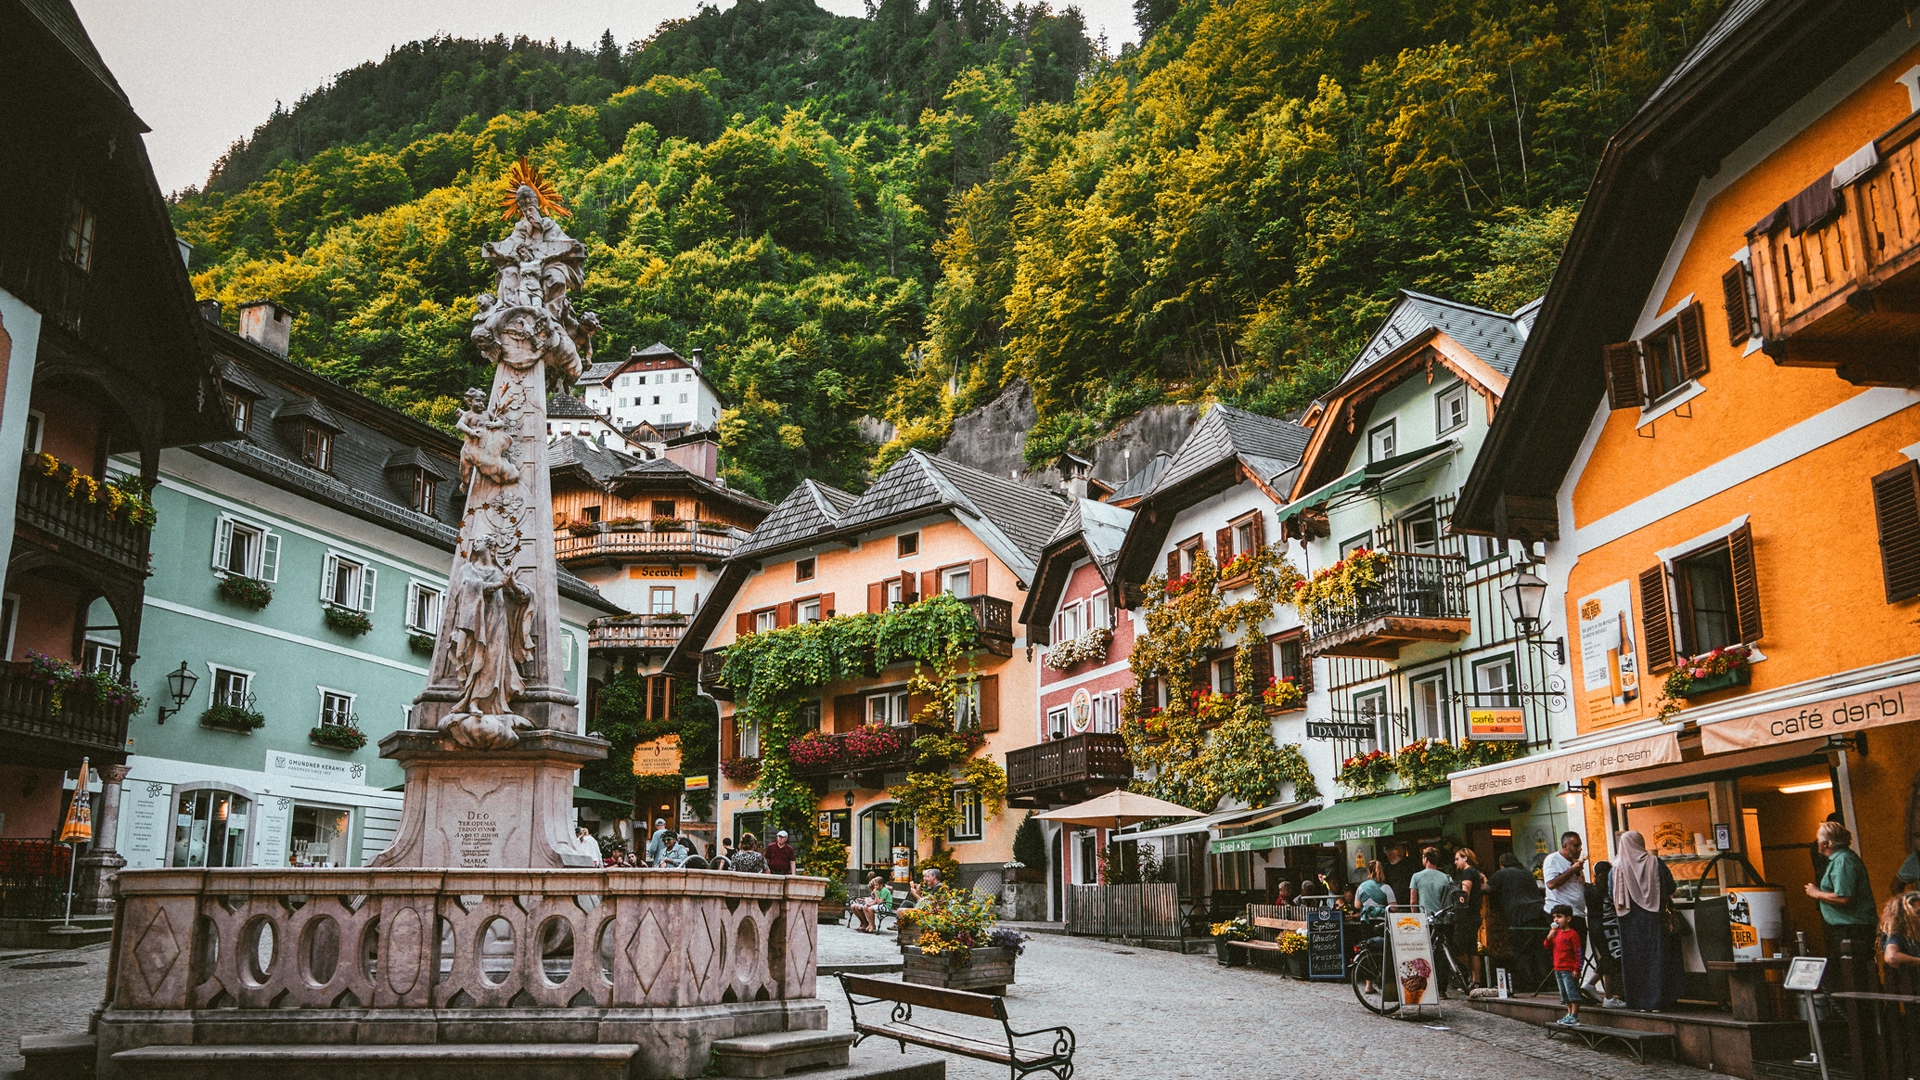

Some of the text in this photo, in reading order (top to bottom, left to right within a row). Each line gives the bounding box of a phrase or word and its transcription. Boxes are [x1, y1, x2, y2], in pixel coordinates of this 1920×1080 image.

[642, 566, 683, 577] Seewirt
[1770, 708, 1824, 736] café
[288, 759, 345, 772] GMUNDNER KERAMIK
[1467, 749, 1651, 793] italienisches eis italian ice-cream
[1220, 842, 1235, 853] Hotel
[1241, 841, 1251, 851] Bar
[1340, 827, 1360, 841] Hotel
[1367, 826, 1382, 838] Bar
